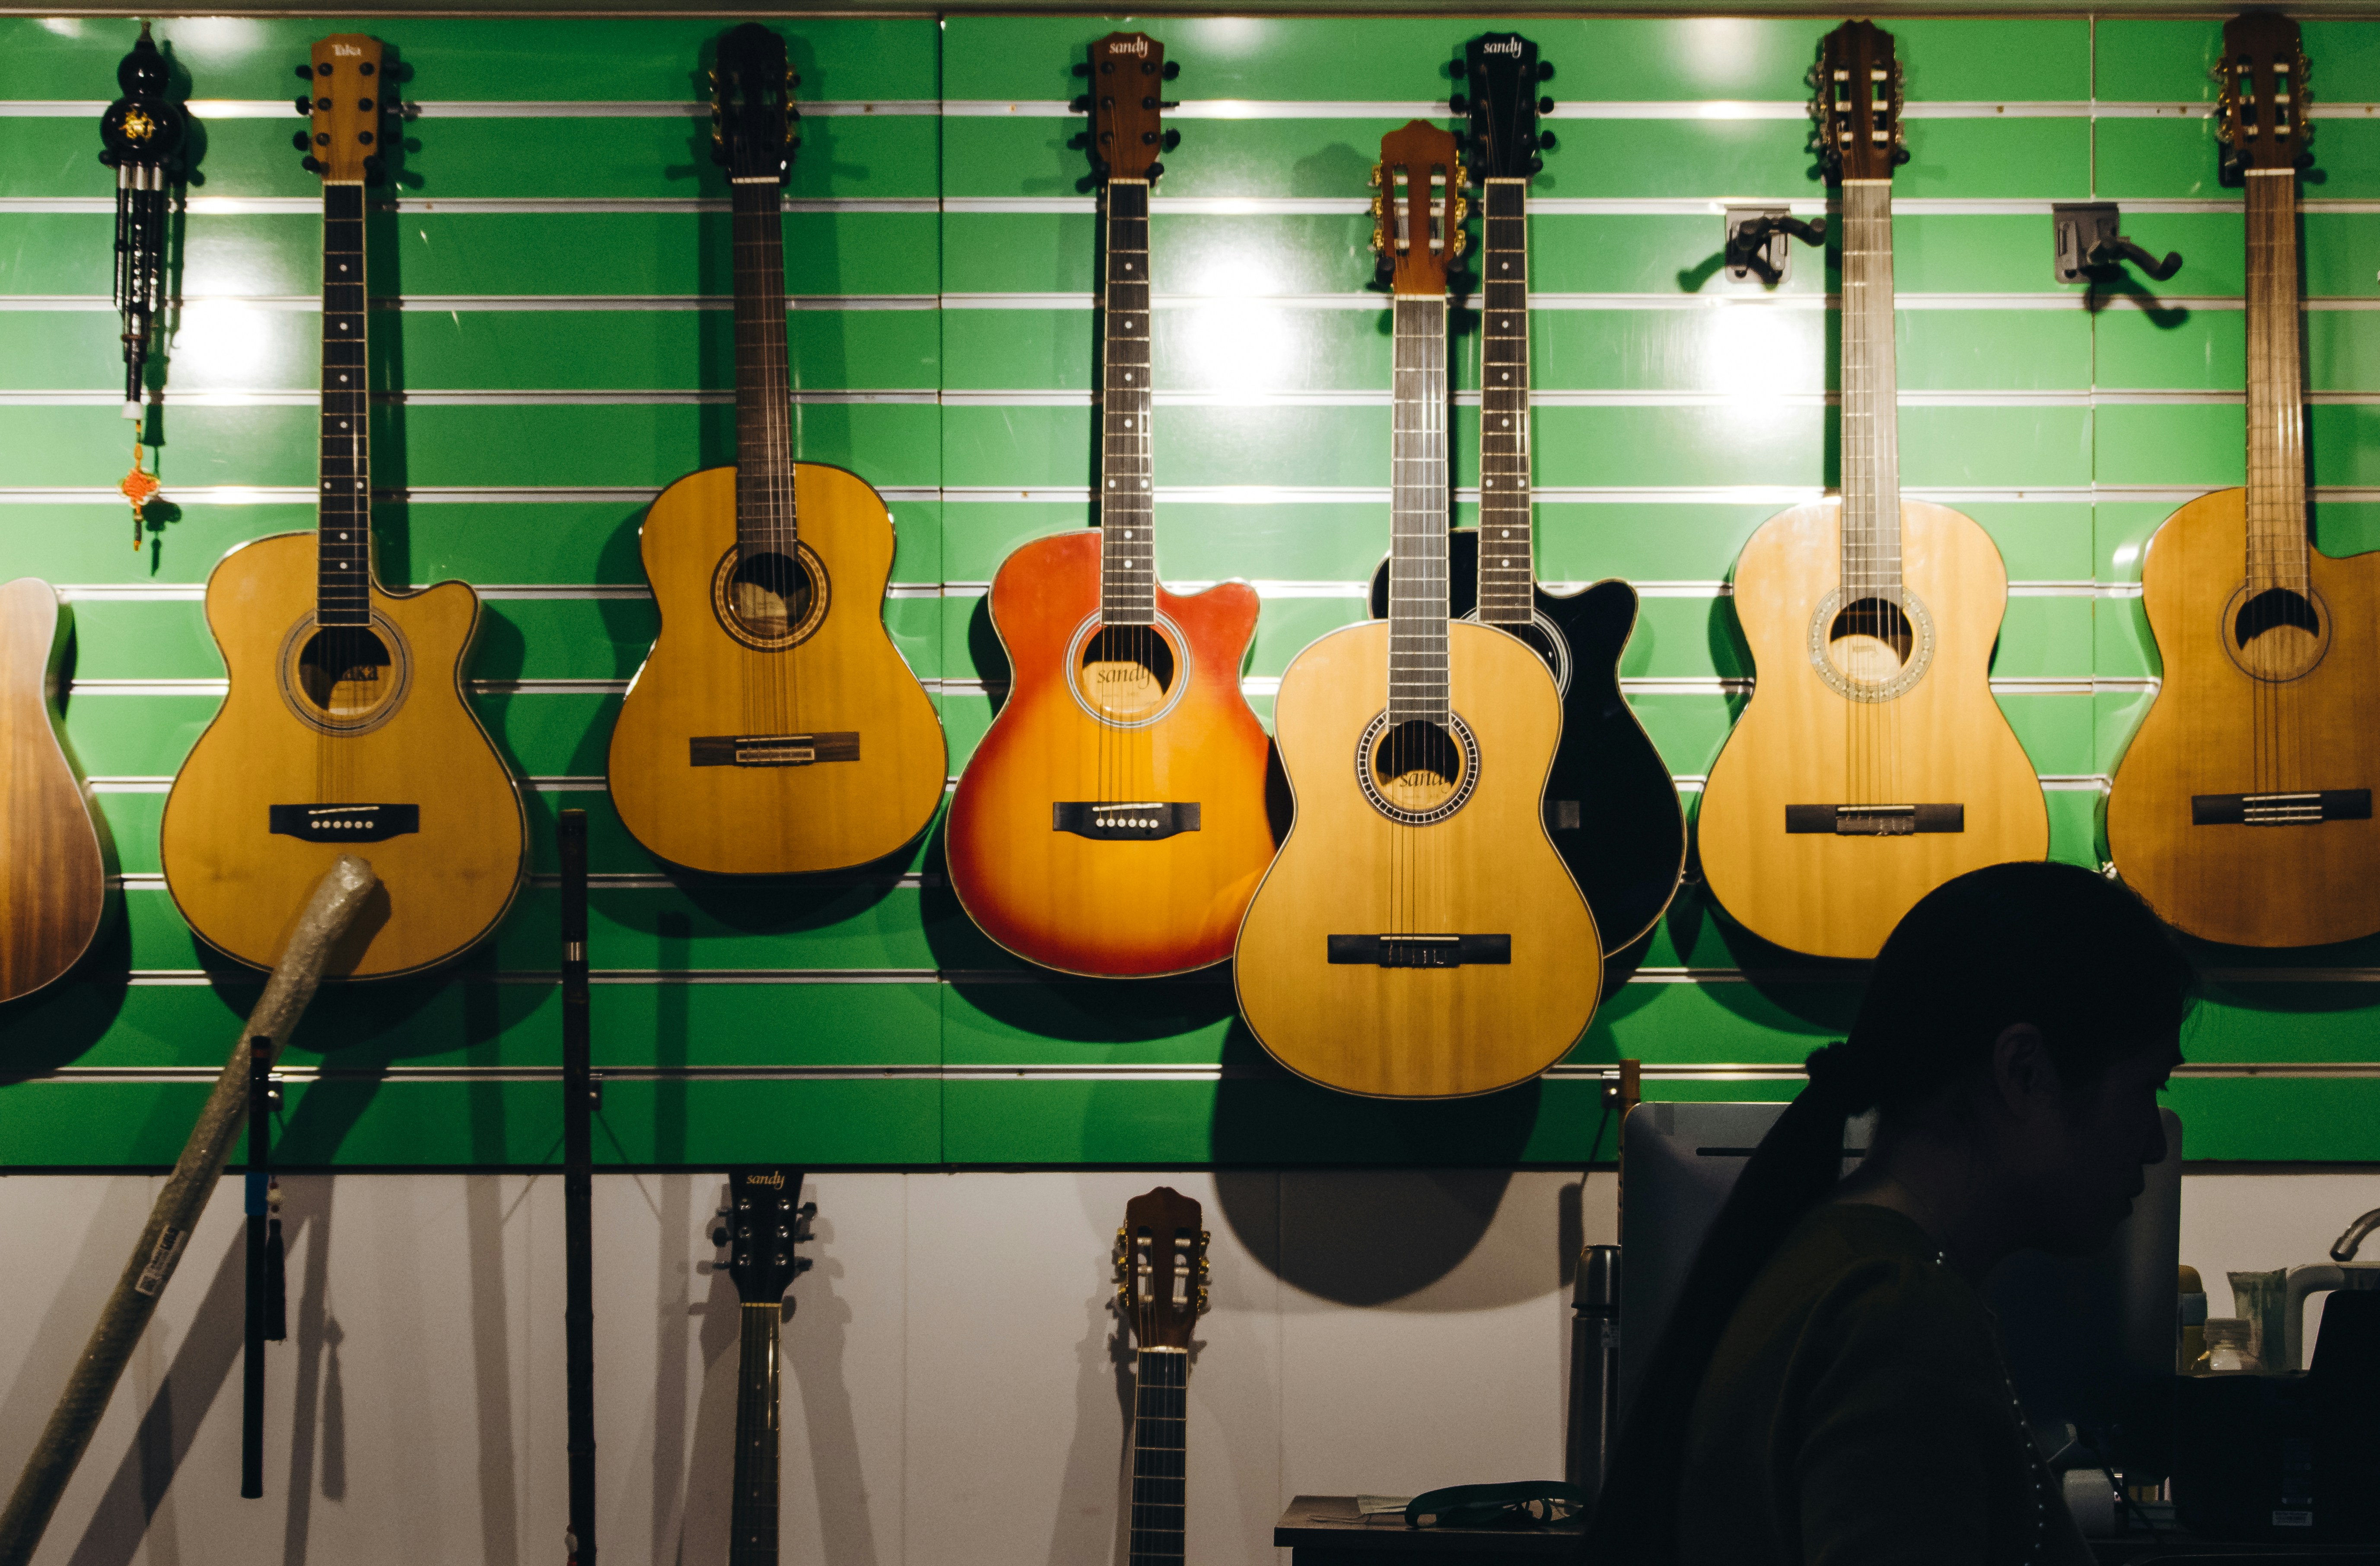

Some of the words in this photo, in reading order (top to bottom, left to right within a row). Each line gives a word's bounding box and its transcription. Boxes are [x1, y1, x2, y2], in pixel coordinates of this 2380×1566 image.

[1109, 36, 1148, 58] sandy
[1483, 37, 1522, 59] sandy
[1097, 664, 1150, 689] sandy
[746, 1170, 785, 1190] sandy
